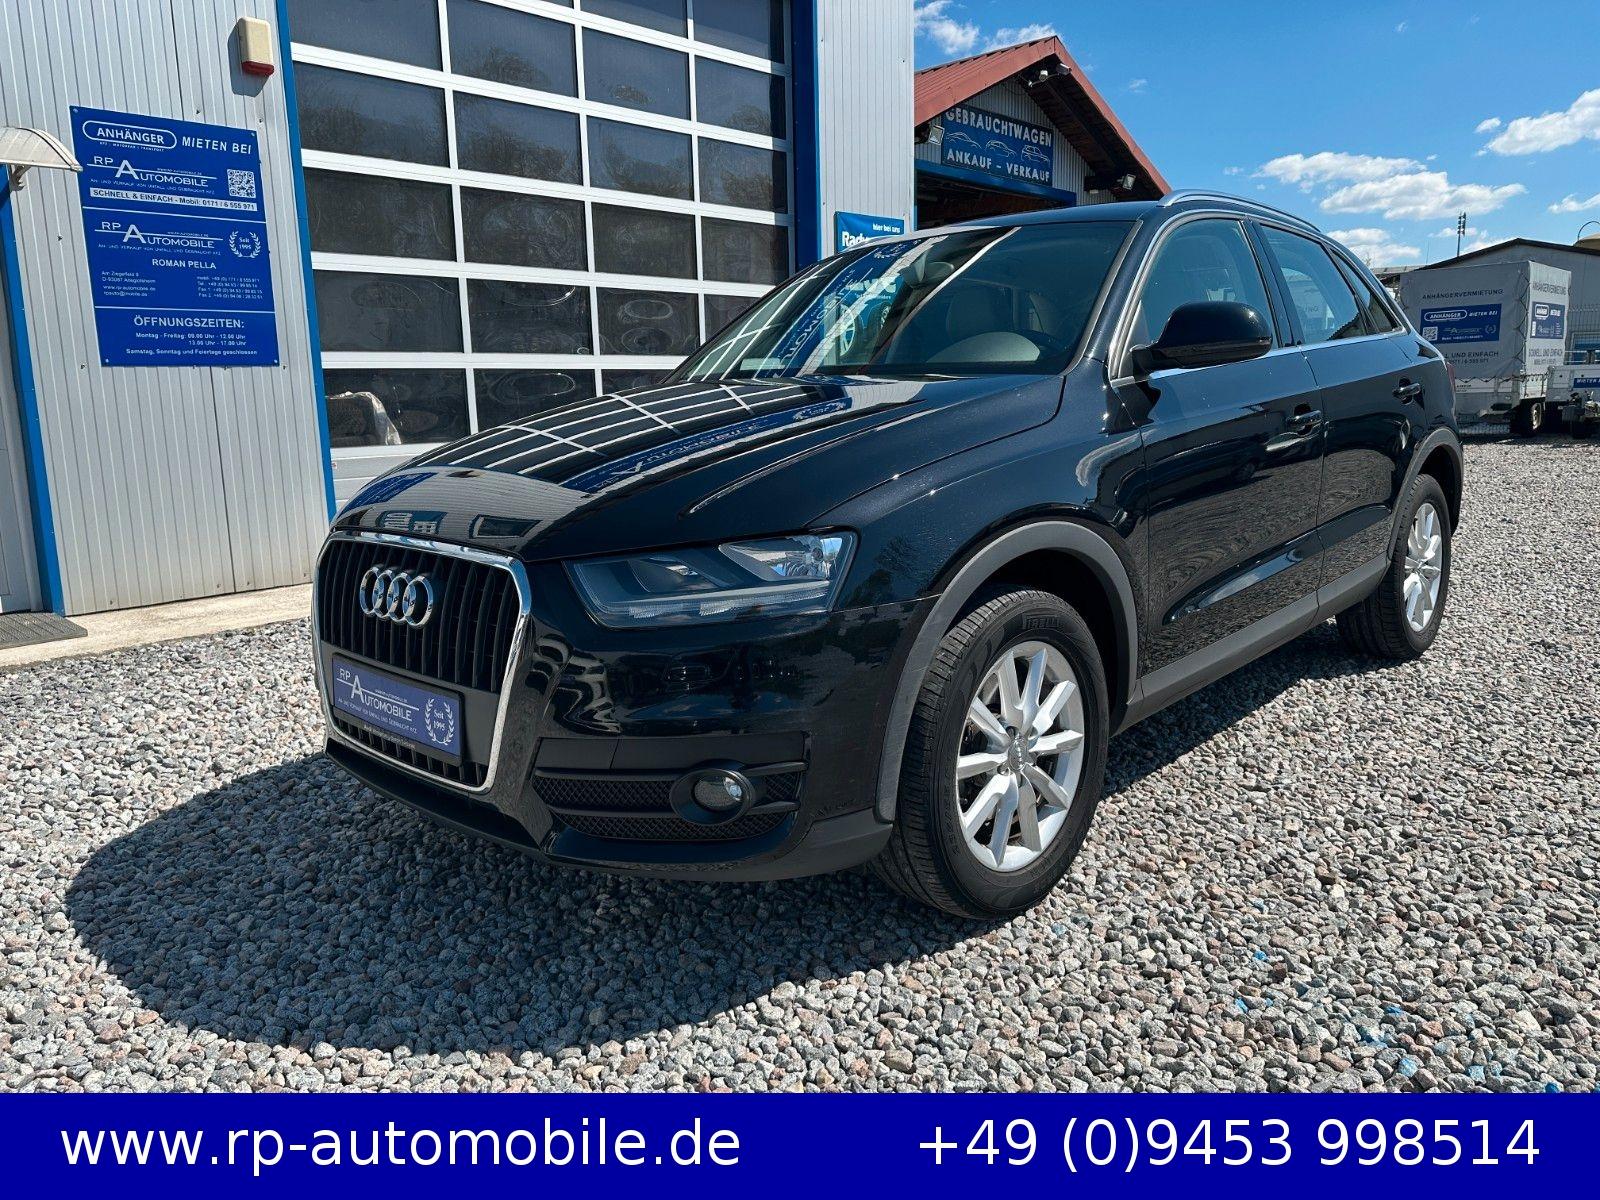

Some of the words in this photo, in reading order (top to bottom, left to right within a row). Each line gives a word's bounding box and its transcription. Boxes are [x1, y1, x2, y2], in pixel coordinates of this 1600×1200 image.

[945, 107, 1052, 147] GEBRAUCHTWAGEN
[97, 128, 164, 144] ANHÄNGER
[182, 136, 227, 151] MIETEN
[232, 144, 251, 154] BEI
[94, 156, 114, 166] RP
[947, 148, 991, 169] ANKAUF
[1006, 162, 1049, 182] VERKAUF
[93, 189, 130, 199] SCHNELL
[140, 193, 173, 202] EINFACH
[180, 197, 200, 205] Mobil:
[202, 199, 218, 207] 0171
[101, 221, 121, 230] RP
[872, 223, 882, 231] hier
[152, 258, 186, 268] ROMAN
[188, 260, 216, 270] PELLA
[134, 315, 245, 328] ÖFFNUNGSZEITEN:
[339, 668, 351, 681] RP
[433, 709, 443, 719] Seit
[433, 721, 445, 731] 1995
